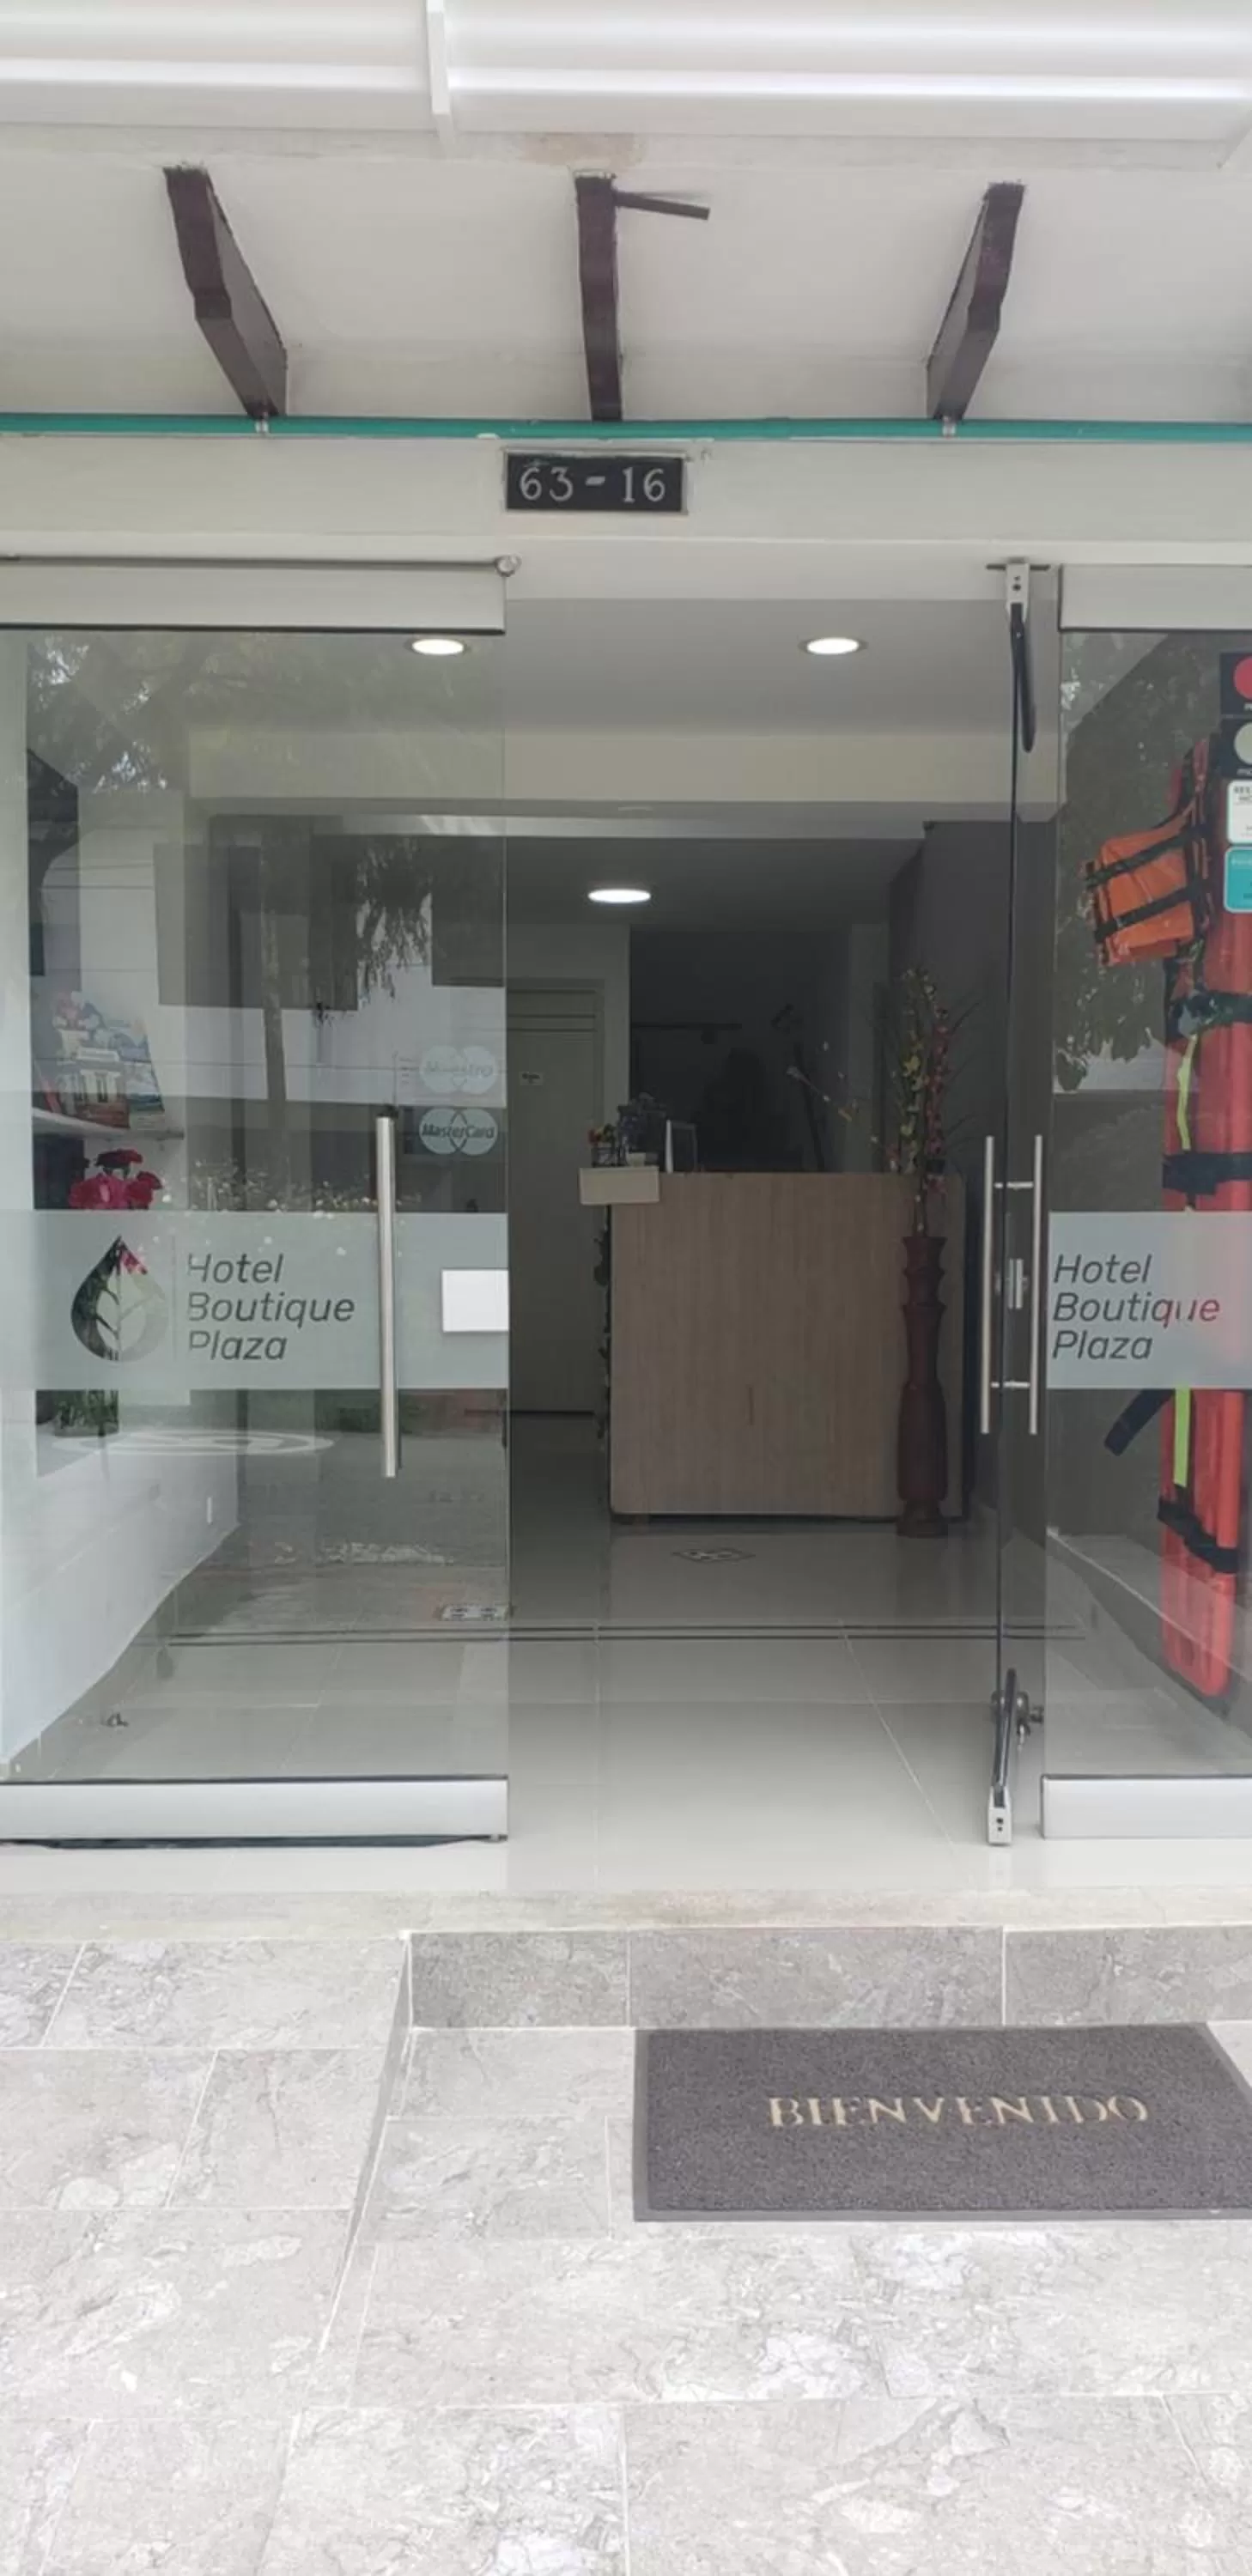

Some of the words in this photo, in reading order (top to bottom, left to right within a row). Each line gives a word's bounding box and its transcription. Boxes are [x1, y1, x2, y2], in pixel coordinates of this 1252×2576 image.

[187, 1253, 284, 1284] Hotel
[1053, 1254, 1152, 1284] Hotel
[187, 1291, 356, 1329] Boutique
[1052, 1291, 1220, 1329] Boutique
[188, 1330, 289, 1360] Plaza
[1052, 1329, 1153, 1360] Plaza
[769, 2094, 1149, 2127] BIENVENIDO
